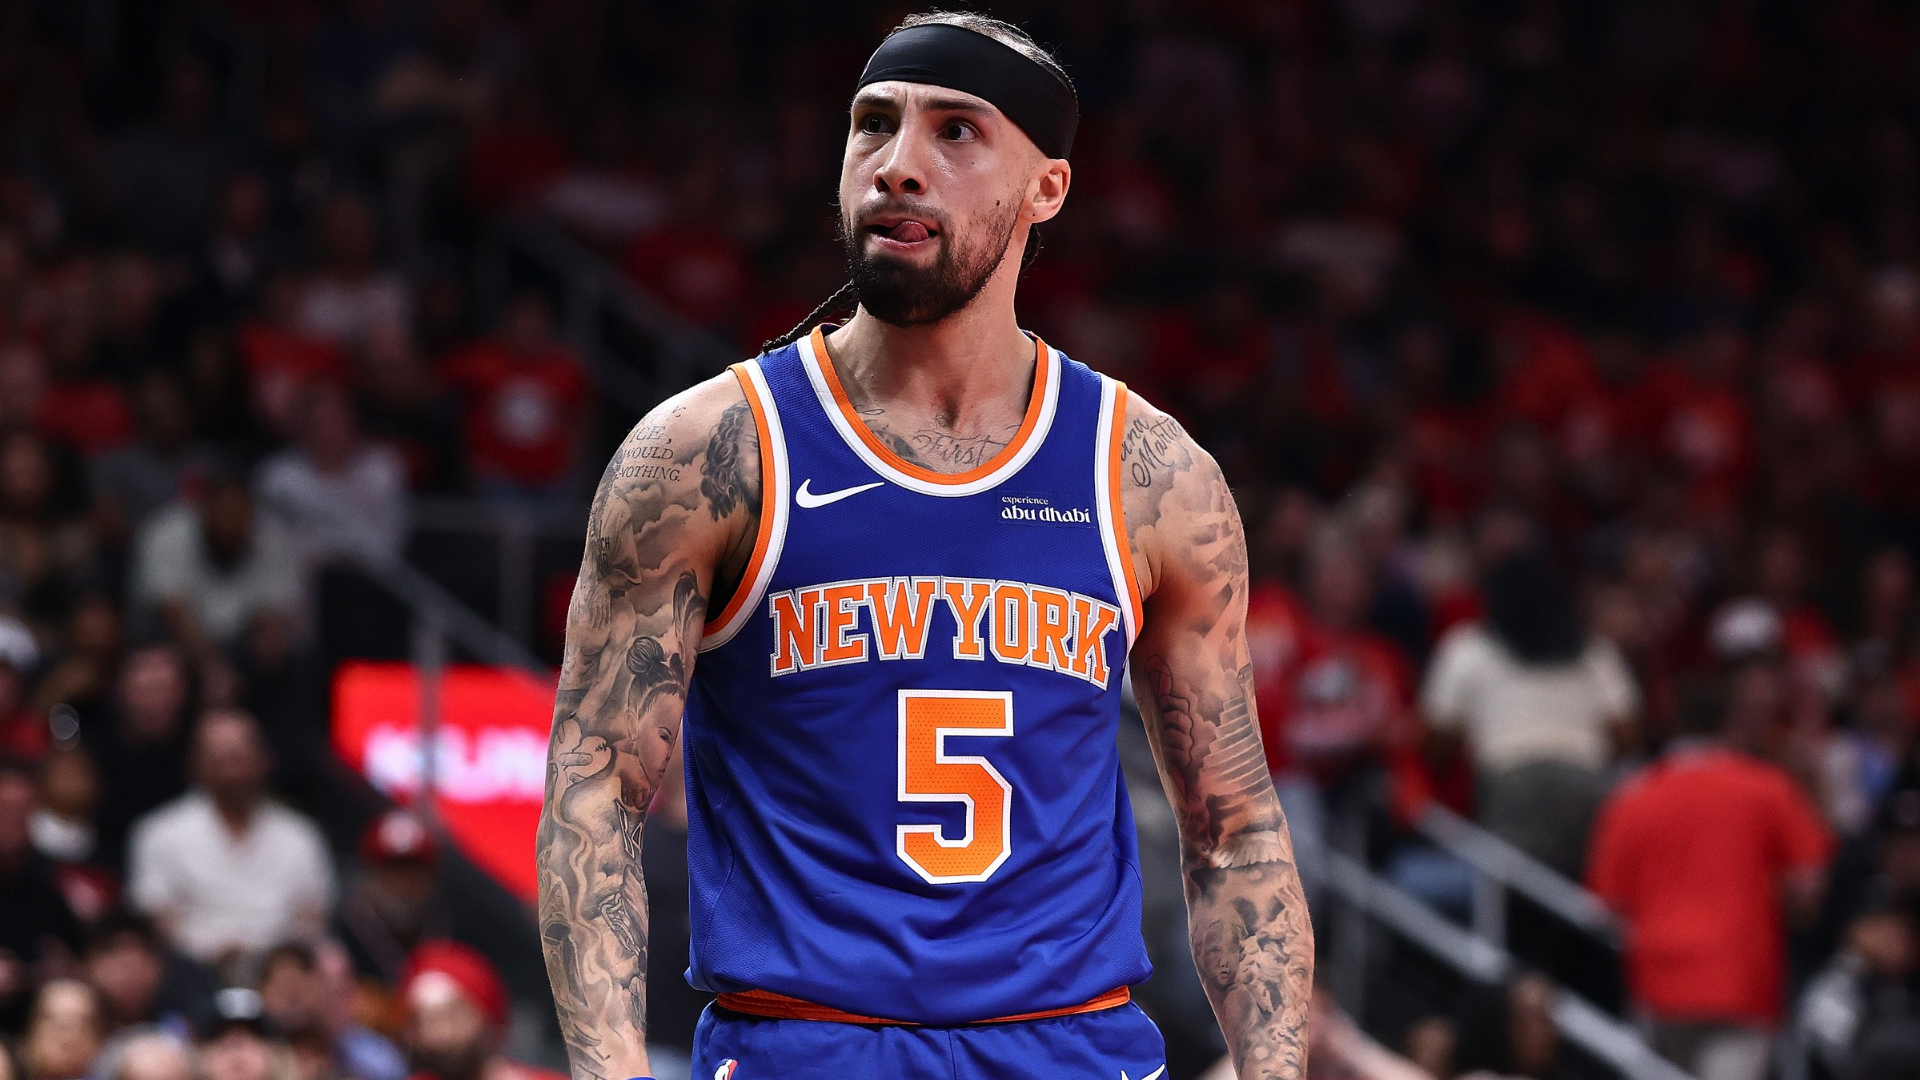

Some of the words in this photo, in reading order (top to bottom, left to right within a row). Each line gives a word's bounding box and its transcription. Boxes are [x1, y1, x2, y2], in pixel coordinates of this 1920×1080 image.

[624, 446, 674, 460] WOULD
[1001, 495, 1049, 505] experience
[1001, 504, 1037, 521] abu
[1039, 507, 1091, 523] dhabi
[769, 575, 941, 678] NEW
[941, 575, 1121, 691] YORK
[897, 689, 1014, 885] 5
